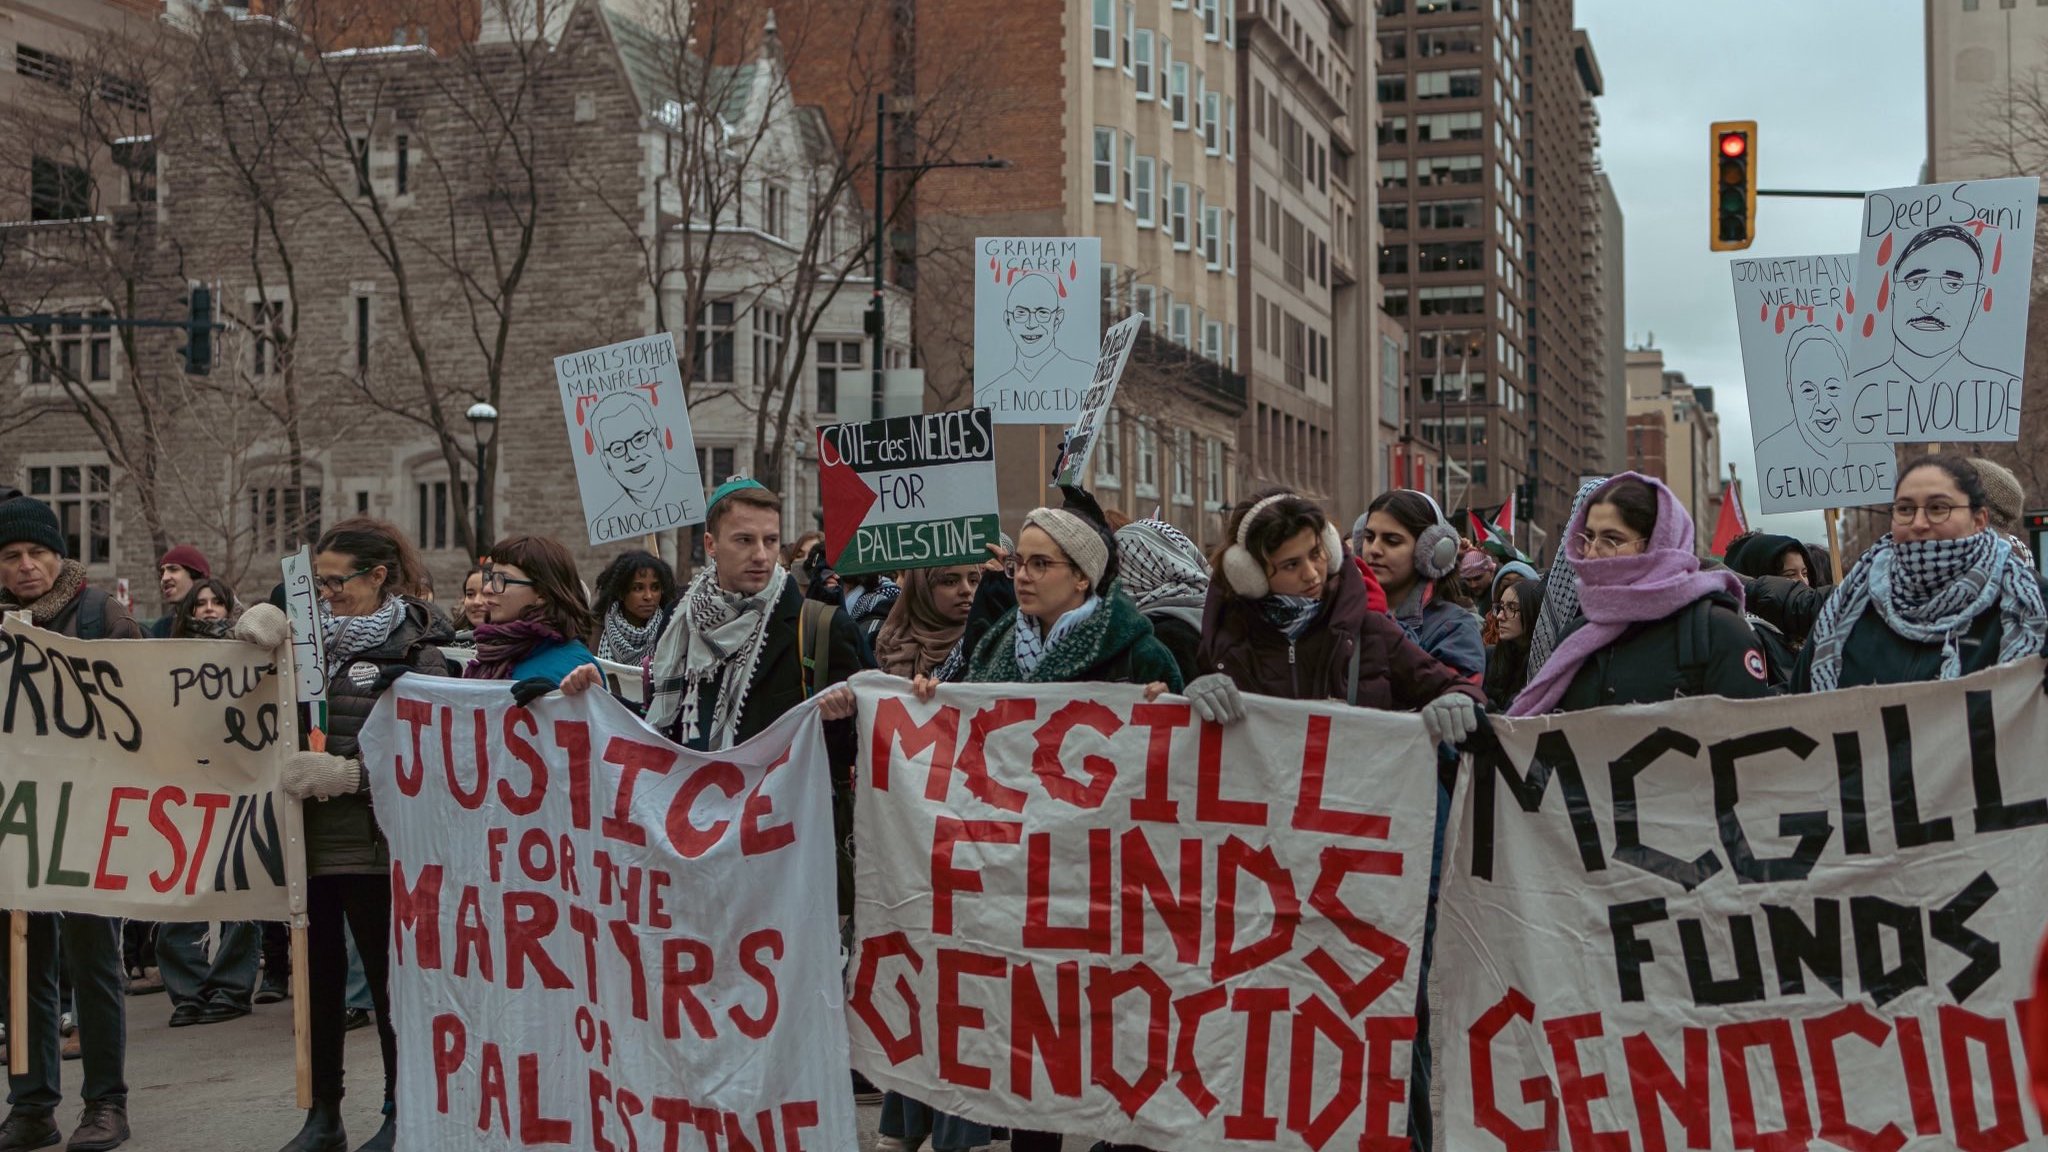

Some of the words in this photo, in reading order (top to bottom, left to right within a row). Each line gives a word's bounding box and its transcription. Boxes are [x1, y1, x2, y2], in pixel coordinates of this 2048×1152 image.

[984, 239, 1076, 258] GRAHAM
[1006, 257, 1063, 273] CARR
[1736, 256, 1851, 286] JONATHAN
[1760, 287, 1843, 309] WENER
[562, 339, 676, 378] CHRISTOPHER
[567, 366, 663, 397] MANFREDI
[1852, 379, 2020, 436] GENOCIDE
[879, 474, 925, 513] FOR
[1766, 462, 1892, 499] GENOCIDE
[596, 499, 700, 541] GENOCIDE
[856, 517, 986, 564] PALESTINE
[395, 697, 796, 859] JUSTICE
[871, 697, 1392, 839] MCGILL
[1471, 689, 2048, 892] MCGILL
[0, 781, 287, 895] ALESTIN
[487, 828, 581, 896] FOR
[593, 850, 673, 929] THE
[931, 815, 1410, 1018] FUNDS
[1608, 870, 2002, 1008] FUNDS
[391, 859, 784, 1040] MARTYRS
[575, 1006, 612, 1067] OF
[848, 931, 1418, 1152] GENOCIDE
